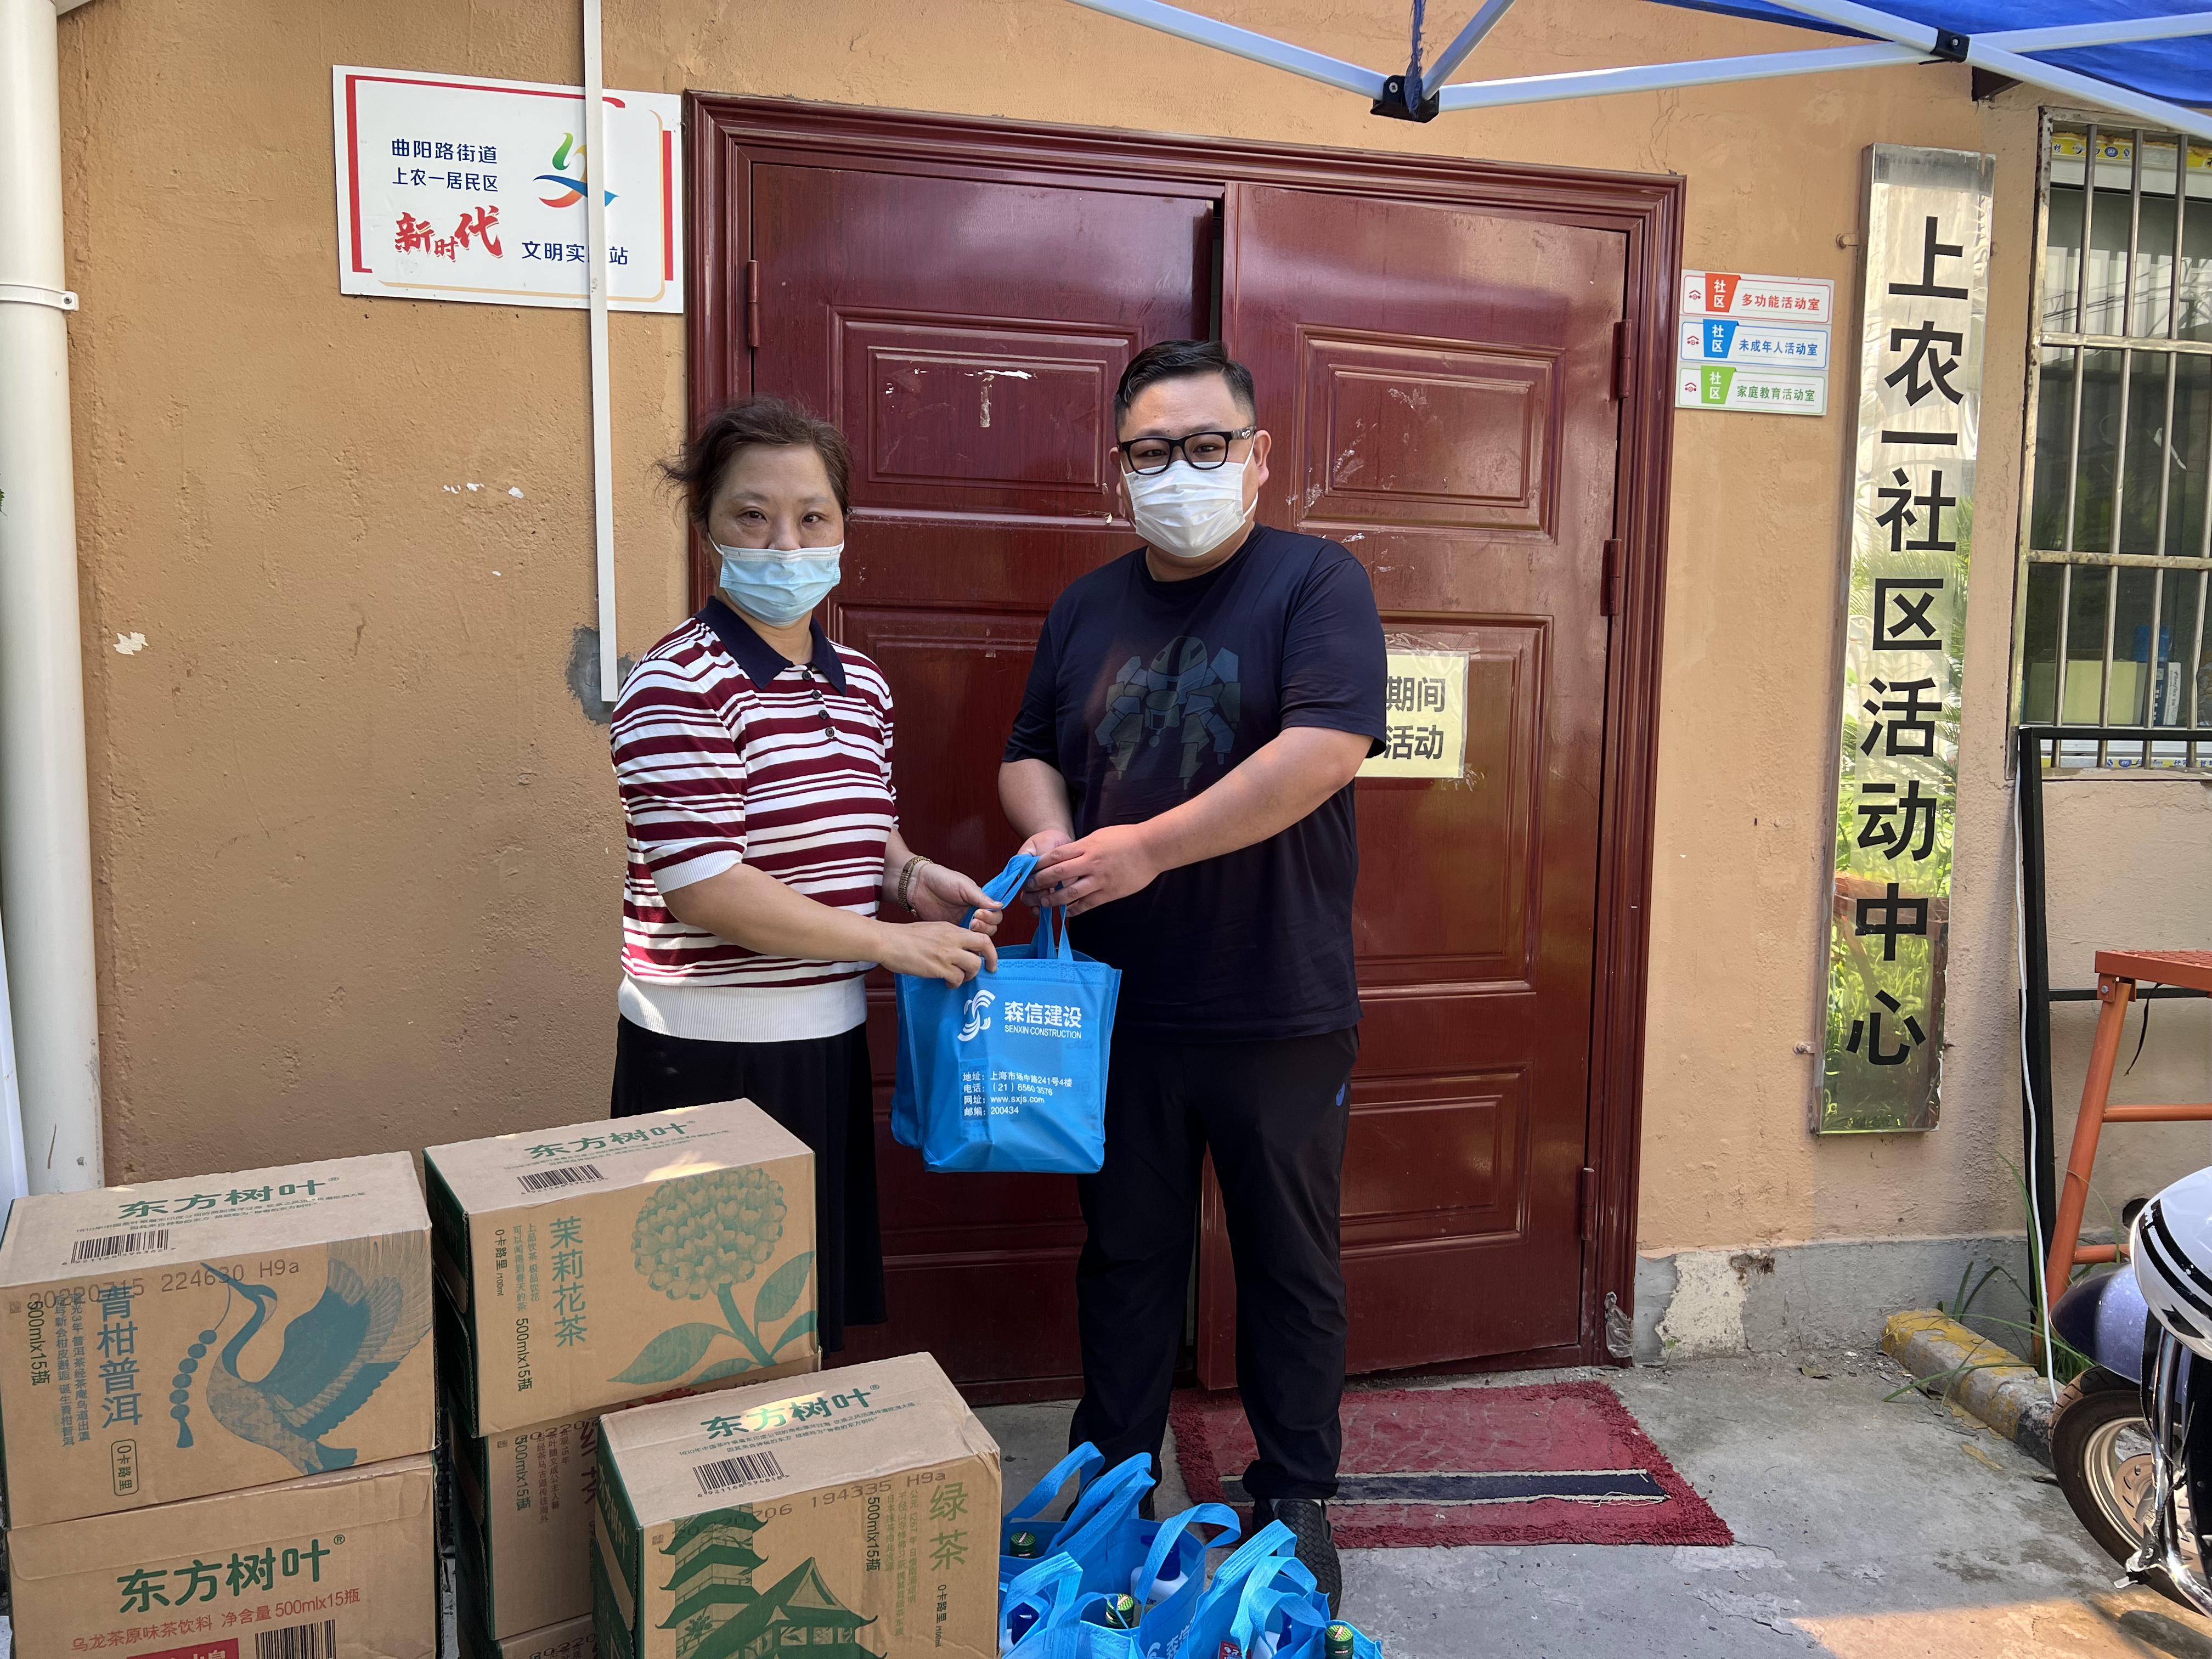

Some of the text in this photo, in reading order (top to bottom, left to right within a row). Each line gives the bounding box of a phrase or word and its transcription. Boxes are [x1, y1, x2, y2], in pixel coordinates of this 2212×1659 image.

[392, 138, 498, 165] 曲阳路街道
[392, 167, 499, 192] 上农一居民区
[394, 205, 504, 263] 新时代
[522, 240, 628, 265] 文明实站
[1714, 279, 1726, 308] 社区
[1742, 293, 1820, 311] 多功能活动室
[1712, 324, 1724, 353] 社区
[1739, 338, 1818, 356] 未成年人活动室
[1709, 371, 1722, 400] 社区
[1737, 385, 1815, 402] 家庭教育活动室
[1846, 216, 1968, 1066] 上农一社区活动中心
[1386, 676, 1446, 712] 期间
[1384, 724, 1444, 760] 活动
[1005, 1001, 1082, 1029] 森信建设
[1005, 1024, 1082, 1039] SENXIN CONSTRUCTION
[990, 1071, 1073, 1087] 上海市场中路241号4楼
[991, 1094, 1045, 1104] www.sxjs.com
[991, 1106, 1019, 1115] 200434
[524, 1122, 687, 1159] 东方树叶
[118, 1180, 325, 1219] 东方树叶
[495, 1229, 507, 1271] 0卡路里
[259, 1259, 299, 1278] H9a
[550, 1216, 588, 1347] 茉莉花茶
[27, 1300, 50, 1386] 500mlx15瓶
[96, 1285, 143, 1429] 青柑普洱
[516, 1317, 532, 1392] 500mlx15瓶
[701, 1388, 871, 1439] 东方树叶
[117, 1445, 132, 1491] 0卡路里
[811, 1479, 893, 1508] 194335
[907, 1471, 946, 1488] H9a
[866, 1496, 881, 1571] 500mlx15瓶
[929, 1481, 969, 1572] 绿茶
[116, 1538, 331, 1614] 东方树叶
[71, 1614, 212, 1652] 乌龙茶原味茶饮料
[221, 1604, 272, 1628] 净含量
[275, 1587, 361, 1618] 500mlx15瓶
[936, 1583, 948, 1624] 0卡路里
